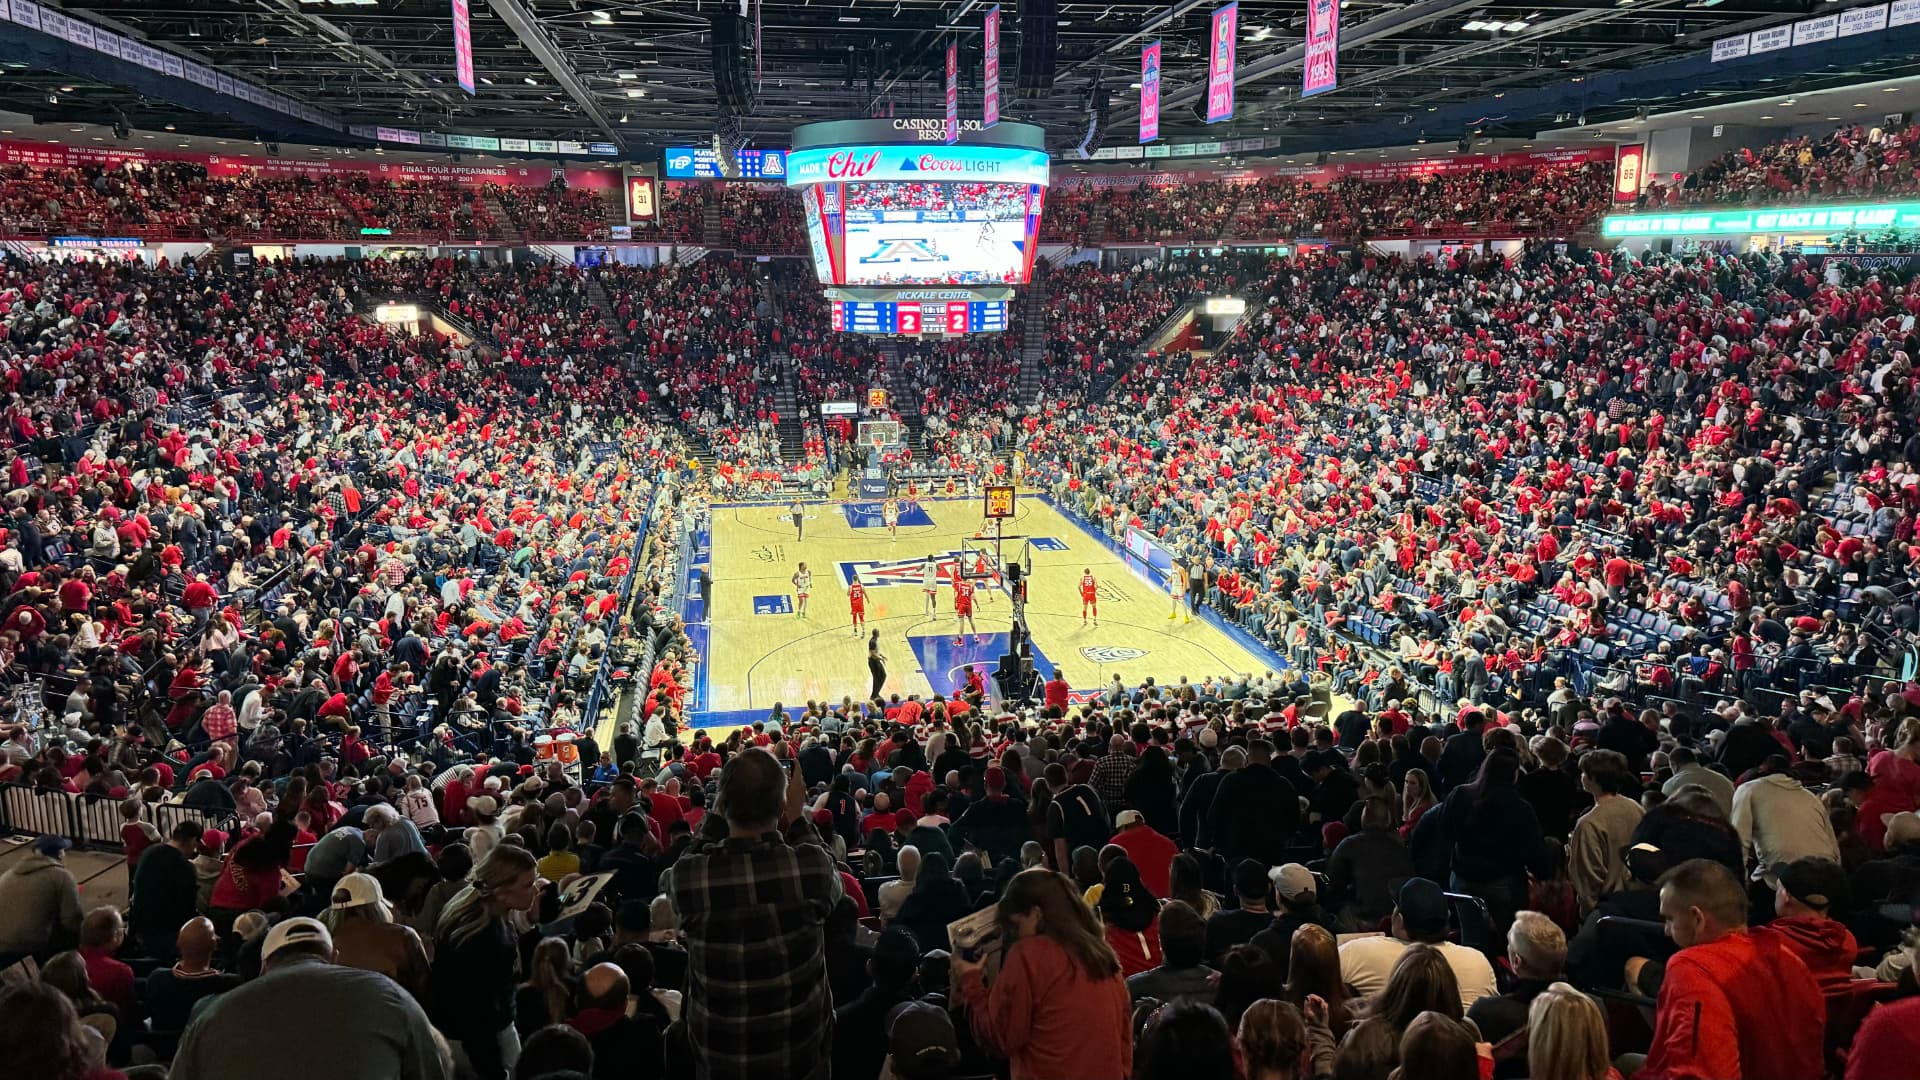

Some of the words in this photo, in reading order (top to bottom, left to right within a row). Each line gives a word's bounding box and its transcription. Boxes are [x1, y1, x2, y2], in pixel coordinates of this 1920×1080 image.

[1311, 61, 1330, 81] 1993
[893, 118, 939, 130] CASINO
[963, 118, 985, 131] SOL
[669, 156, 689, 169] TEP
[799, 162, 821, 174] MADE
[918, 154, 963, 172] Coors
[965, 161, 1001, 172] LIGHT
[401, 165, 425, 173] FINAL
[427, 166, 449, 174] FOUR
[451, 167, 507, 176] APPEARANCES
[638, 195, 647, 204] 31
[1778, 212, 1811, 226] BACK
[896, 291, 936, 300] MCKALE
[938, 291, 972, 300] CENTER
[902, 315, 915, 329] 2
[952, 315, 964, 329] 2
[1084, 578, 1093, 587] 55
[414, 798, 428, 810] 15
[1122, 883, 1131, 893] B
